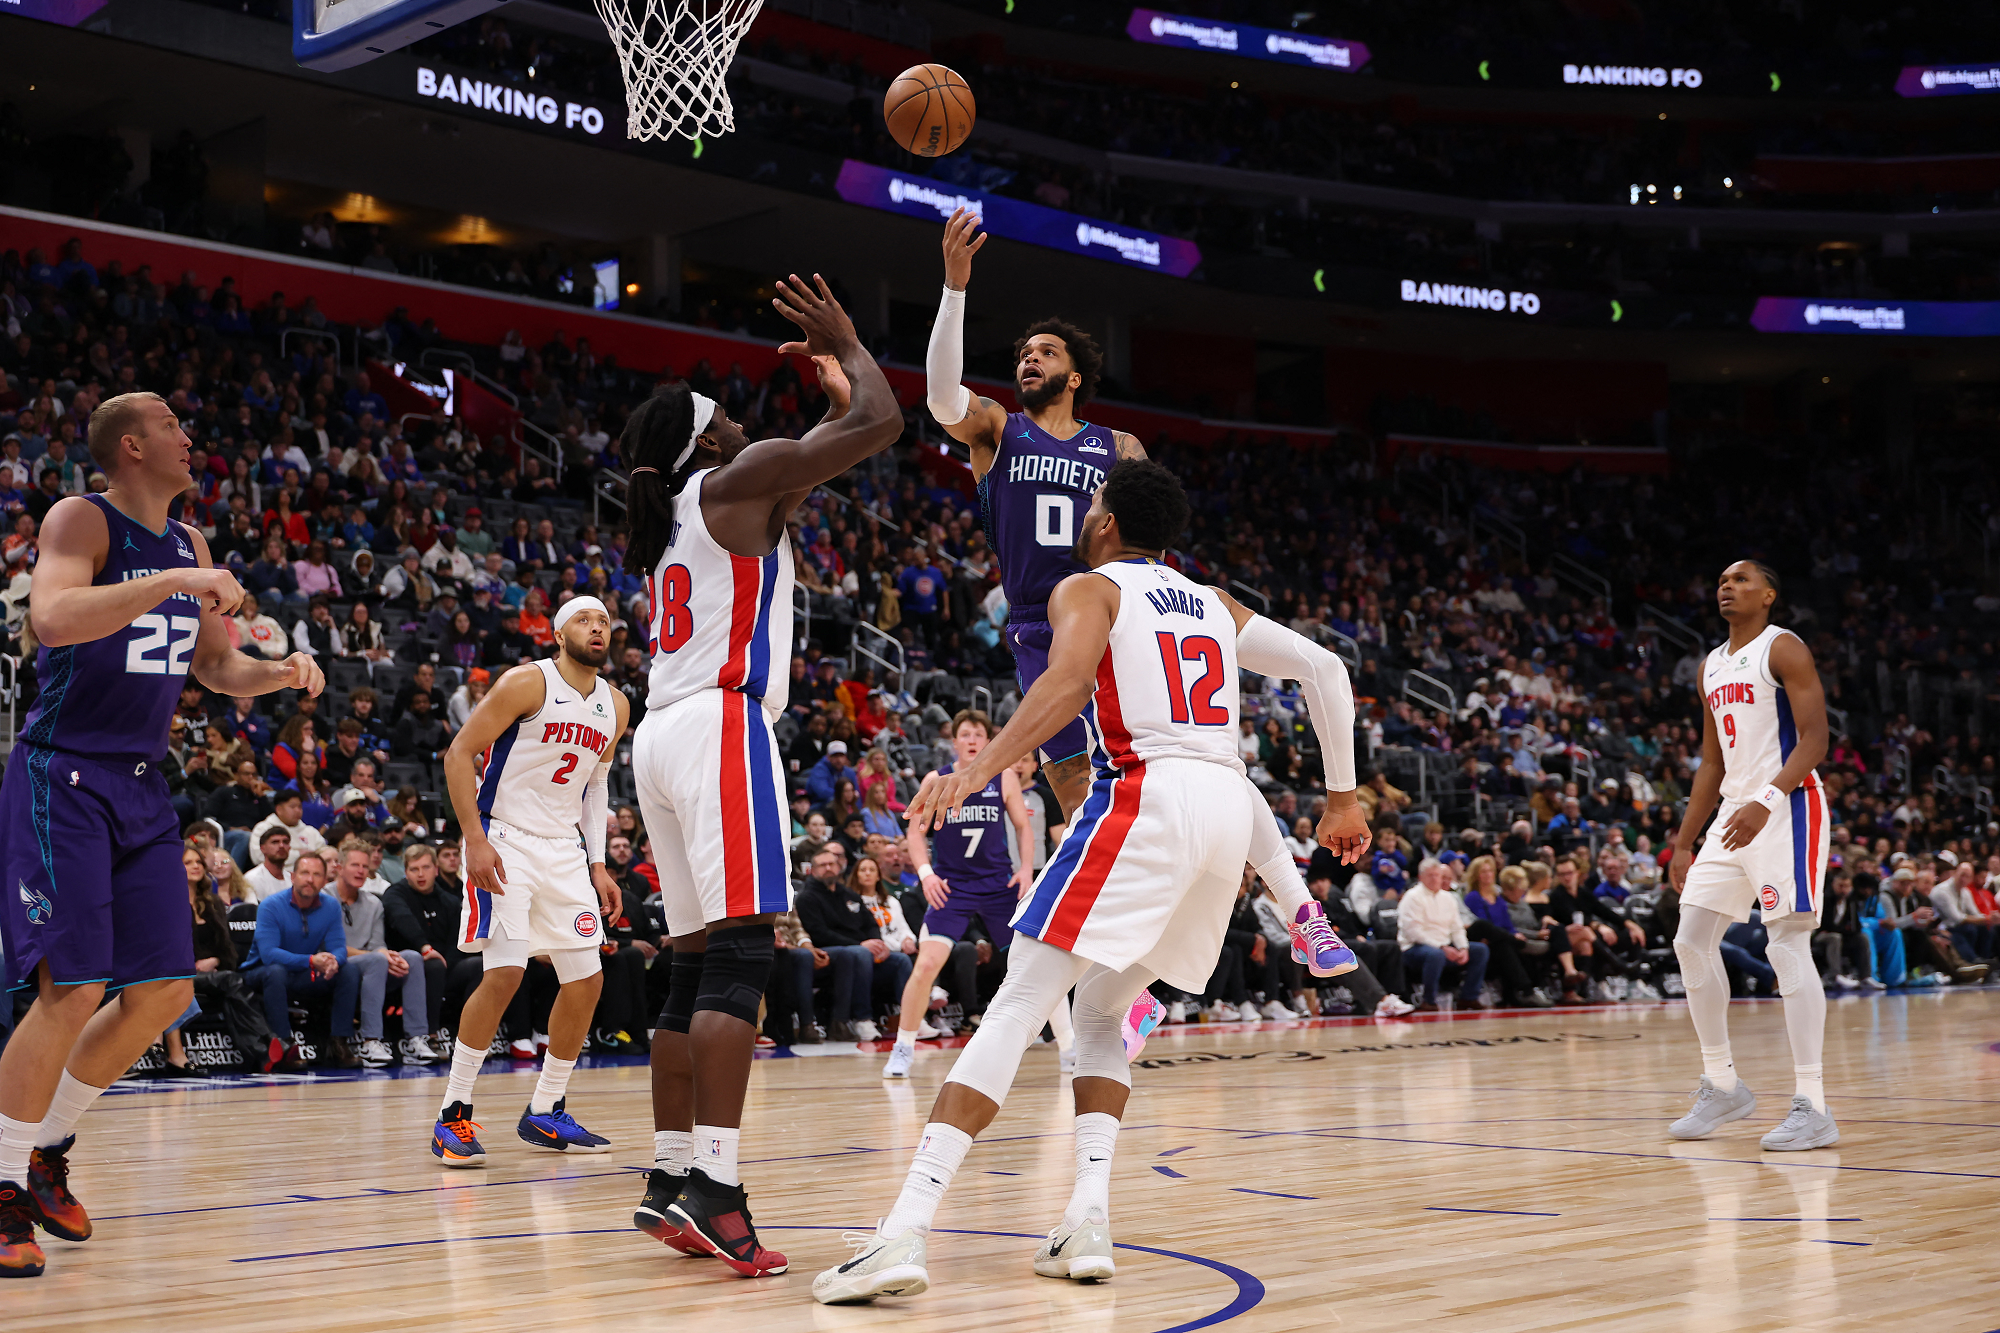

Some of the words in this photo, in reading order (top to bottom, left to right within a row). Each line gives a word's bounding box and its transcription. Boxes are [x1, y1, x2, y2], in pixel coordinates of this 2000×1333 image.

[1563, 64, 1668, 87] BANKING
[1671, 68, 1703, 88] FO
[417, 67, 558, 124] BANKING
[565, 102, 604, 134] FO
[1401, 279, 1506, 311] BANKING
[1509, 291, 1540, 315] FO
[1007, 455, 1105, 494] HORNETS
[1035, 494, 1074, 547] 0
[1145, 588, 1205, 620] HARRIS
[125, 613, 200, 675] 22
[1155, 631, 1229, 726] 12
[541, 722, 608, 756] PISTONS
[1723, 714, 1736, 748] 9
[551, 752, 579, 784] 2
[961, 828, 985, 858] 7
[186, 1031, 233, 1050] Little
[183, 1049, 244, 1067] aesars
